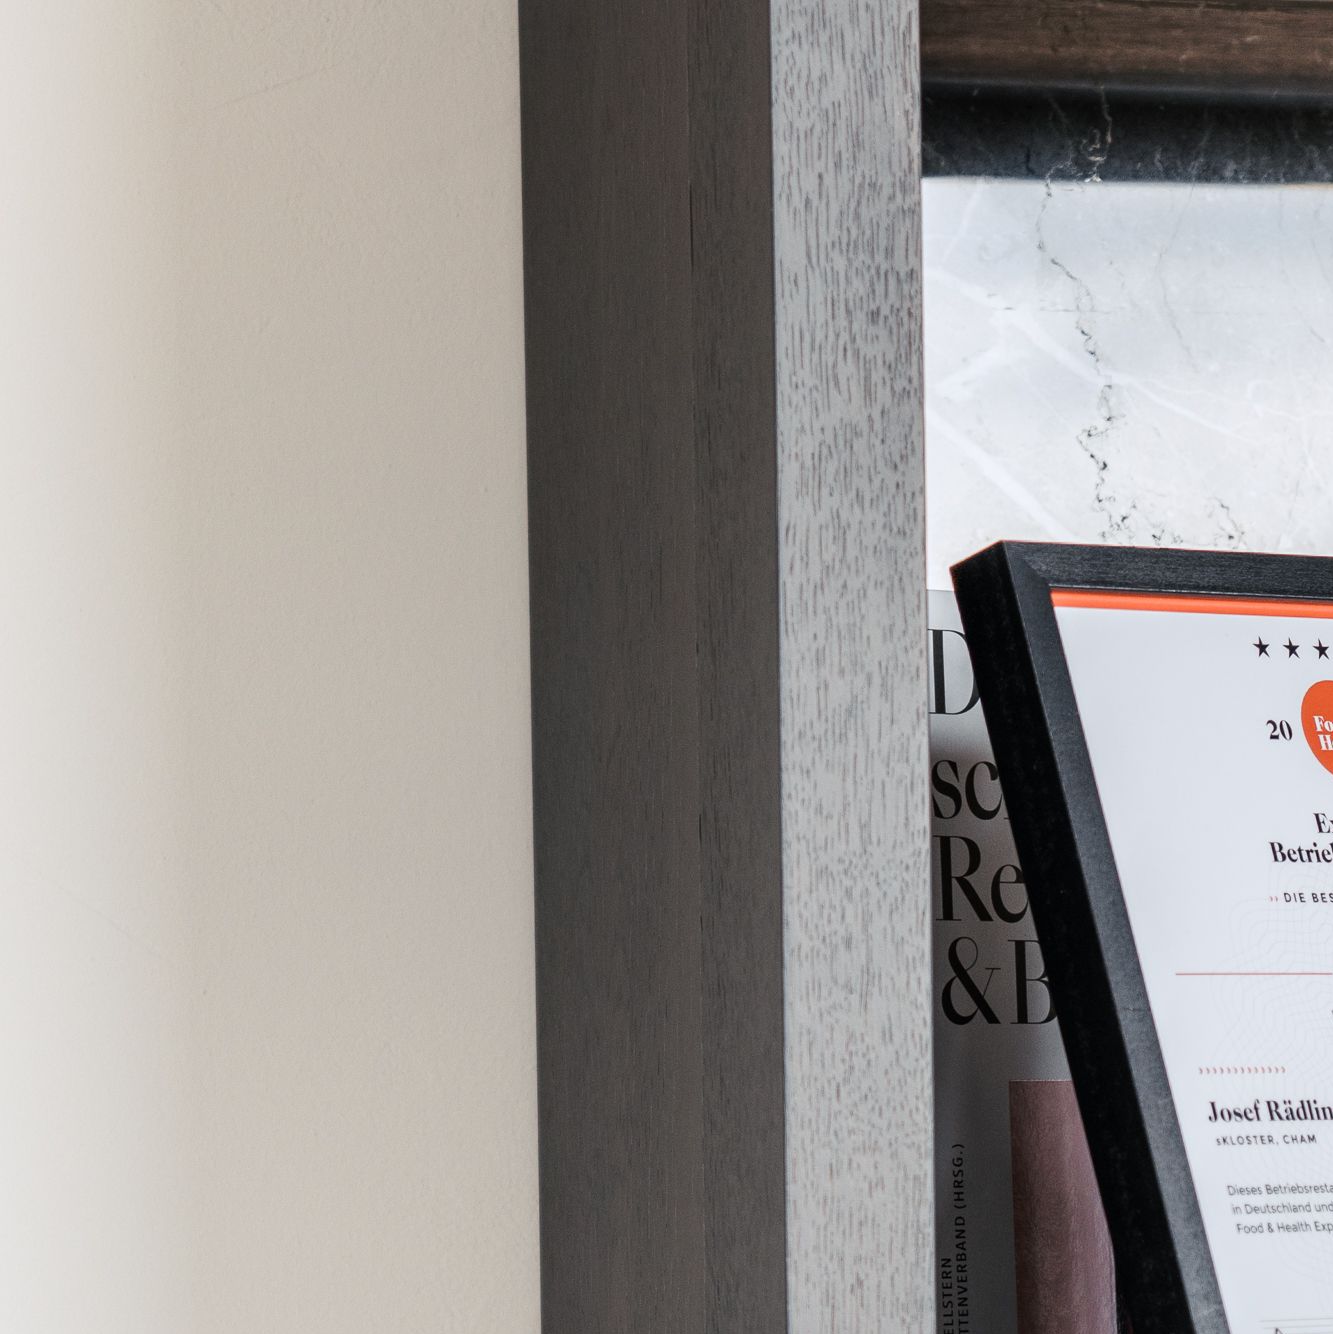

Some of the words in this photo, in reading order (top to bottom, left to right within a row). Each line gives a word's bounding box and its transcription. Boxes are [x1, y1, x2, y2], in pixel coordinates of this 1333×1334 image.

[928, 628, 980, 715] D
[1266, 720, 1293, 741] 20
[932, 759, 1009, 821] sc
[936, 834, 1029, 924] Re
[1283, 893, 1306, 904] DIE
[941, 936, 1001, 1025] &
[1008, 939, 1058, 1025] B
[1208, 1100, 1263, 1123] Josef
[1283, 1135, 1317, 1144] CHAM
[951, 1143, 967, 1209] (HRSG.)
[1227, 1184, 1262, 1196] Dieses
[1232, 1203, 1242, 1214] in
[1245, 1201, 1311, 1214] Deutschland
[1314, 1200, 1333, 1213] und
[1237, 1222, 1264, 1234] Food
[1267, 1222, 1274, 1233] &
[1277, 1221, 1311, 1233] Health
